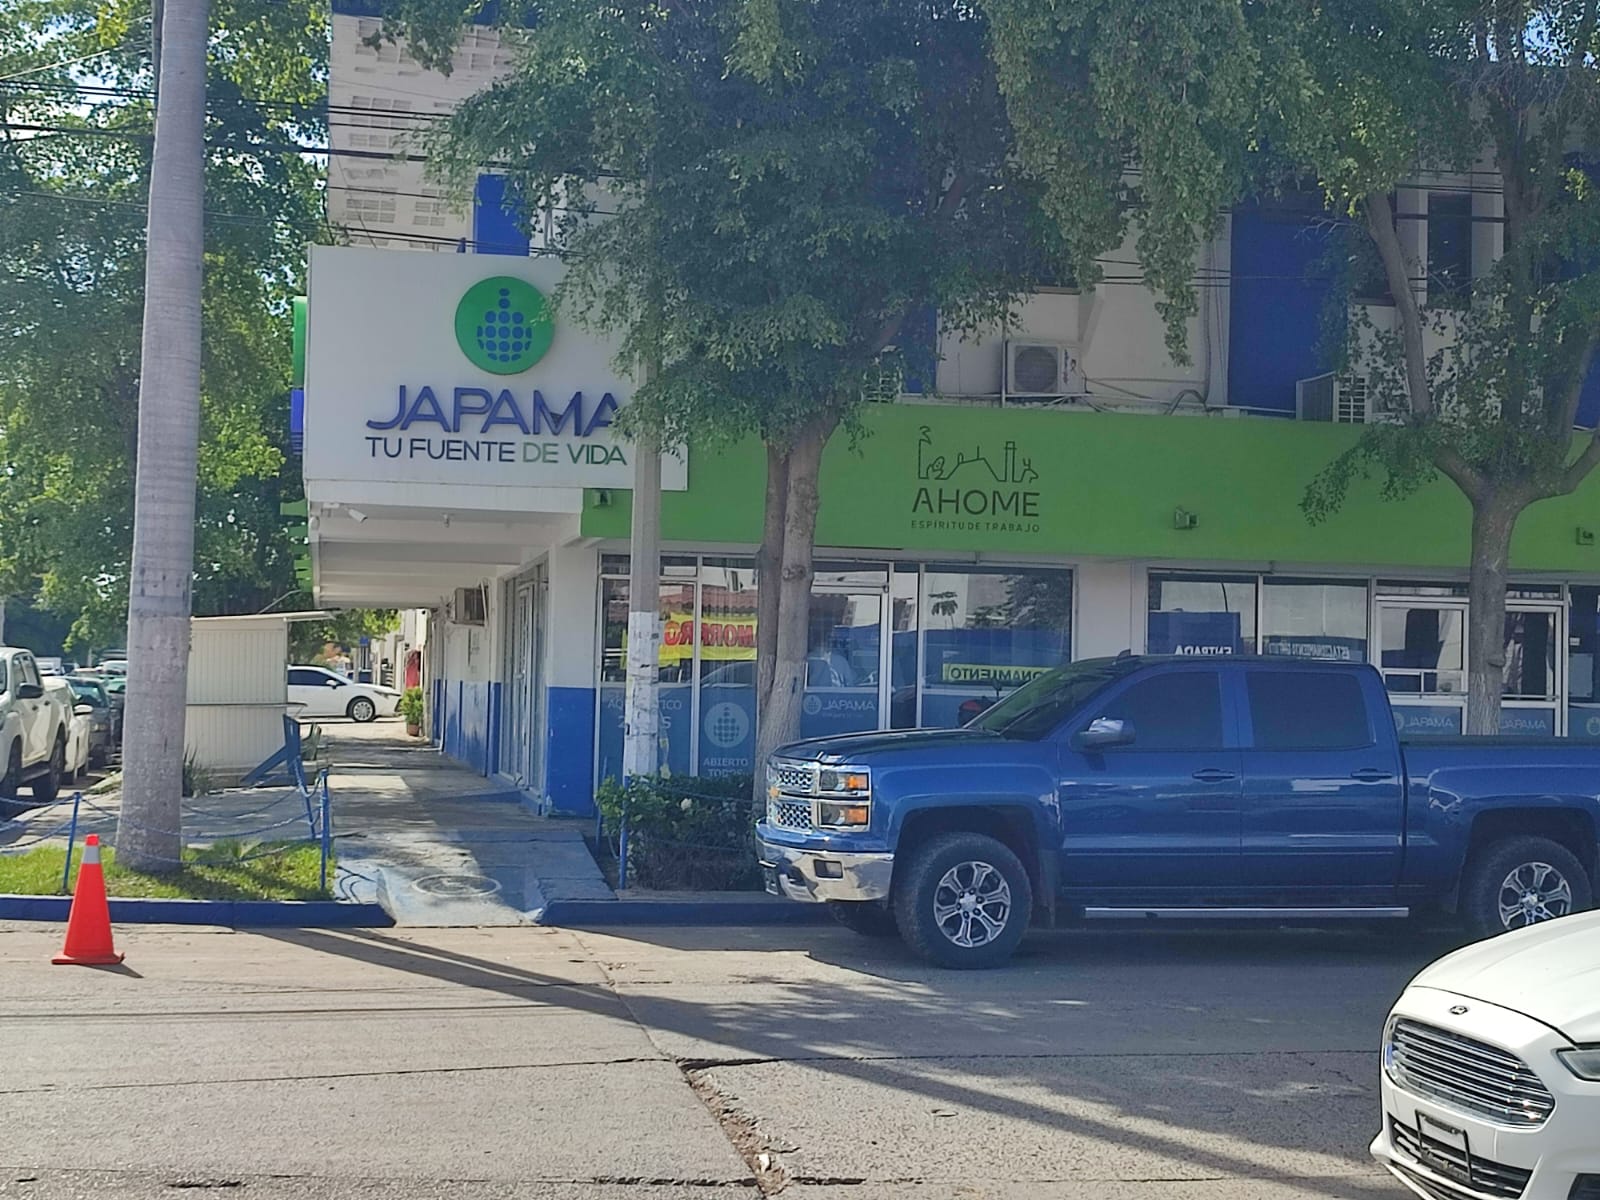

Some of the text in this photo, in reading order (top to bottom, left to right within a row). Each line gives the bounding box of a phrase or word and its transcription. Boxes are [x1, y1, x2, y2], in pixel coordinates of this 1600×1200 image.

[366, 385, 631, 437] JAPAMA
[365, 436, 628, 466] TU FUENTE DE VIDA
[911, 487, 1041, 517] AHOME
[967, 521, 980, 531] DE
[985, 522, 1040, 533] TRABAJO
[822, 699, 876, 711] JAPAMA
[1405, 715, 1454, 728] JAPAMA
[1500, 718, 1546, 730] JAPAMA
[703, 757, 749, 767] ABIERTO
